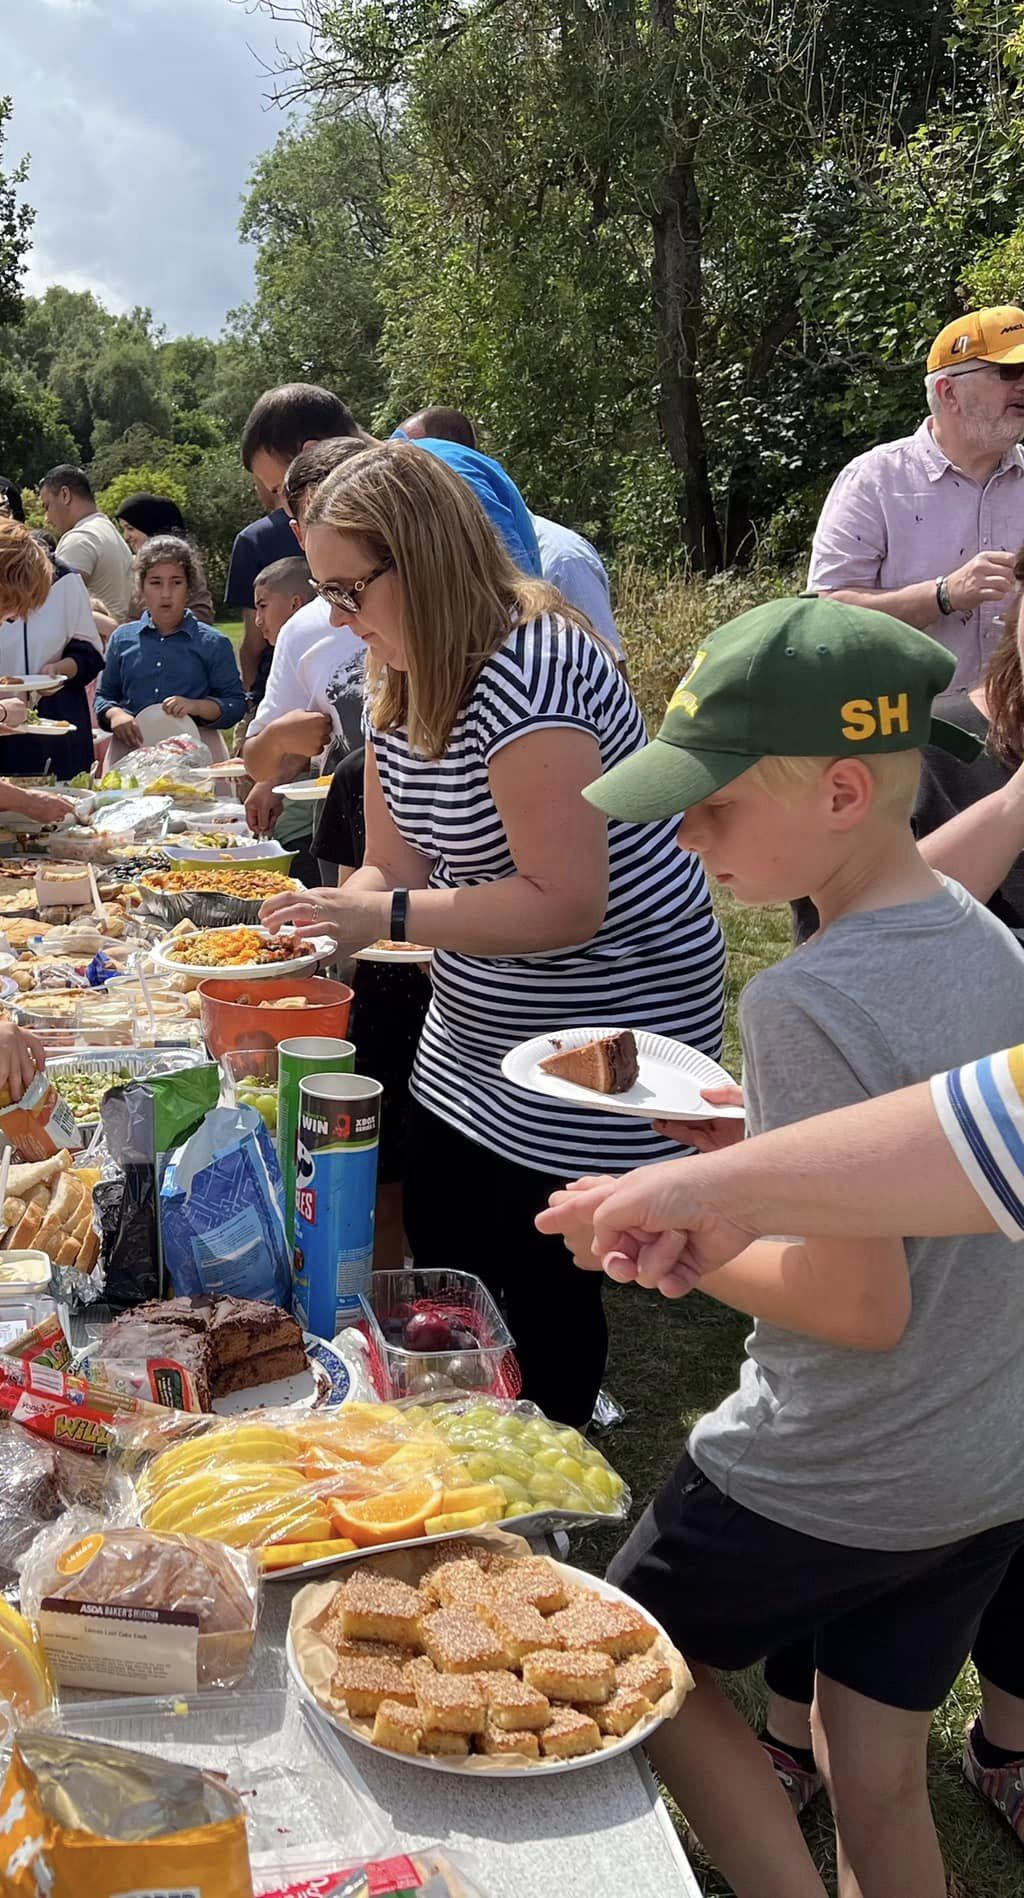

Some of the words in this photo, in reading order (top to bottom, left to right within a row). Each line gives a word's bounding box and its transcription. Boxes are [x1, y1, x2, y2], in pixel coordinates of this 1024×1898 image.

[840, 693, 910, 741] SH
[302, 1114, 329, 1135] WIN
[355, 1115, 376, 1127] XBOX
[80, 1604, 104, 1615] ASDA
[104, 1607, 133, 1619] BAKER'S
